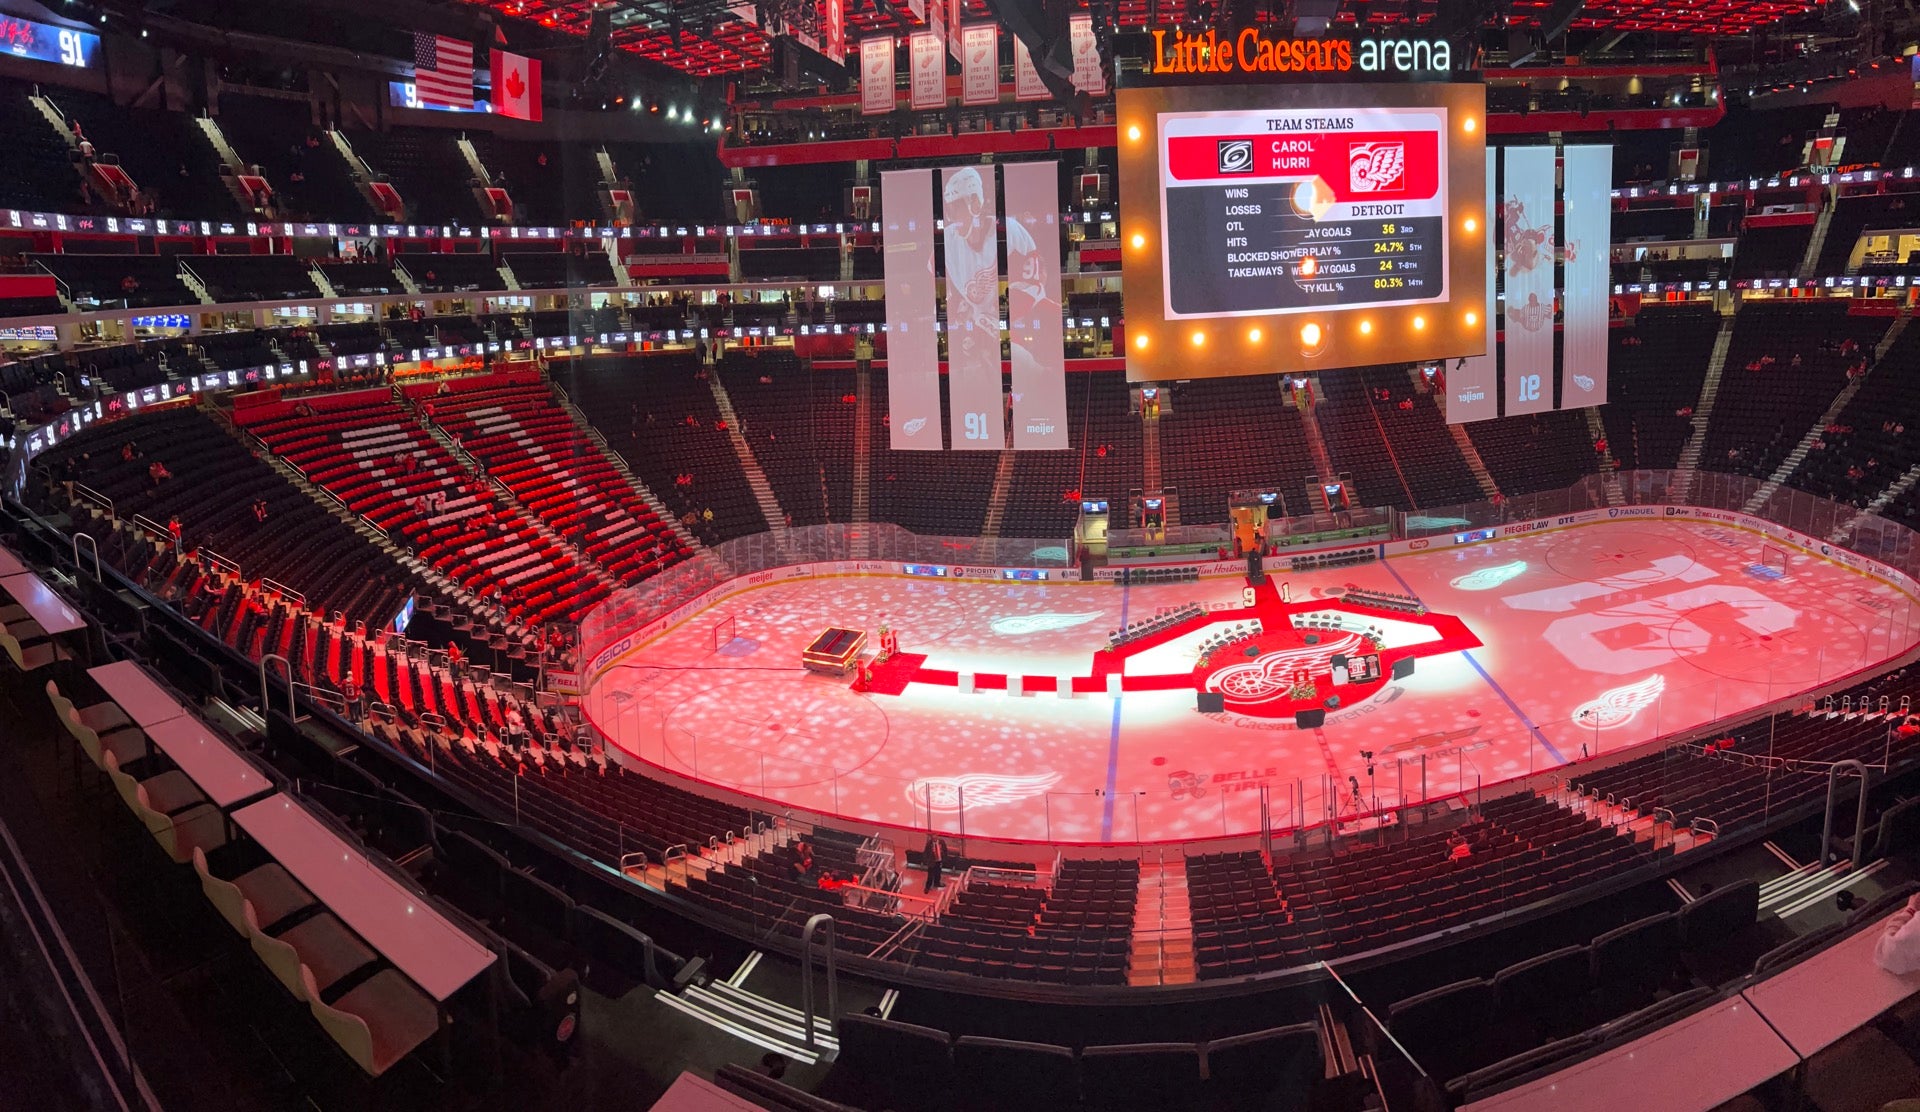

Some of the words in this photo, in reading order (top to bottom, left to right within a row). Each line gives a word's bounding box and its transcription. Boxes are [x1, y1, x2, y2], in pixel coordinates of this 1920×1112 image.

[831, 0, 839, 42] 9
[59, 31, 85, 67] 91
[1152, 28, 1233, 73] Little
[1237, 28, 1352, 73] Caesars
[1360, 38, 1450, 72] arena
[1267, 119, 1302, 131] TEAM
[1272, 141, 1315, 153] CAROL
[1272, 157, 1310, 169] HURRI
[1863, 171, 1872, 181] 91
[1904, 168, 1912, 178] 91
[1709, 183, 1717, 192] 91
[1225, 188, 1249, 199] WINS
[1226, 205, 1262, 216] LOSSES
[1351, 204, 1405, 217] DETROIT
[10, 211, 21, 227] 91
[57, 215, 67, 230] 91
[1083, 212, 1091, 222] 91
[108, 218, 118, 232] 91
[157, 220, 167, 234] 91
[201, 222, 210, 235] 91
[248, 223, 257, 235] 91
[284, 223, 293, 236] 91
[328, 224, 337, 236] 91
[370, 225, 378, 236] 91
[763, 226, 771, 235] 91
[1226, 222, 1245, 232] OTL
[408, 226, 416, 237] 91
[481, 227, 489, 238] 91
[511, 227, 518, 238] 91
[547, 228, 555, 238] 91
[584, 228, 592, 237] 91
[623, 227, 631, 237] 91
[1304, 228, 1320, 238] AY
[1321, 226, 1352, 238] GOALS
[1382, 224, 1395, 235] 36
[1227, 238, 1248, 247] HITS
[1309, 246, 1332, 257] PLAY
[1333, 246, 1341, 256] %
[1374, 242, 1404, 253] 24.7%
[1409, 243, 1422, 251] 5TH
[1228, 251, 1270, 263] BLOCKED
[1228, 266, 1283, 278] TAKEAWAYS
[1329, 263, 1356, 274] GOALS
[1380, 261, 1392, 271] 24
[1316, 282, 1335, 293] KILL
[1336, 282, 1344, 291] %
[1374, 278, 1403, 289] 80.3%
[1825, 277, 1834, 287] 91
[1896, 276, 1904, 286] 91
[1067, 319, 1075, 328] 91
[1101, 317, 1109, 327] 91
[734, 328, 742, 337] 91
[801, 325, 809, 335] 91
[834, 324, 842, 334] 91
[867, 323, 875, 333] 91
[634, 332, 642, 342] 91
[668, 330, 676, 340] 91
[476, 343, 483, 354] 91
[536, 338, 545, 349] 91
[412, 350, 420, 361] 91
[445, 346, 453, 357] 91
[338, 357, 347, 369] 91
[376, 353, 385, 365] 91
[266, 366, 275, 379] 91
[300, 361, 308, 373] 91
[228, 371, 238, 385] 91
[192, 377, 199, 391] 91
[161, 384, 170, 399] 91
[127, 392, 137, 408] 91
[964, 412, 989, 440] 91
[1026, 421, 1055, 436] meijer
[1091, 503, 1099, 512] 91
[1620, 508, 1655, 516] FANDUEL
[1558, 516, 1575, 525] DTE
[1457, 535, 1464, 543] 91
[1486, 529, 1493, 538] 91
[906, 566, 914, 574] 91
[937, 568, 944, 576] 91
[966, 567, 997, 575] PRIORITY
[1006, 571, 1014, 579] 91
[1038, 571, 1046, 579] 91
[1197, 565, 1212, 576] Tim
[1213, 563, 1248, 574] Hortons
[748, 571, 774, 585] meijer
[595, 638, 631, 670] GEICO
[1324, 704, 1377, 726] arena
[1382, 738, 1495, 770] CHEVROLET
[1212, 768, 1277, 783] BELLE
[1219, 782, 1268, 794] TIRE
